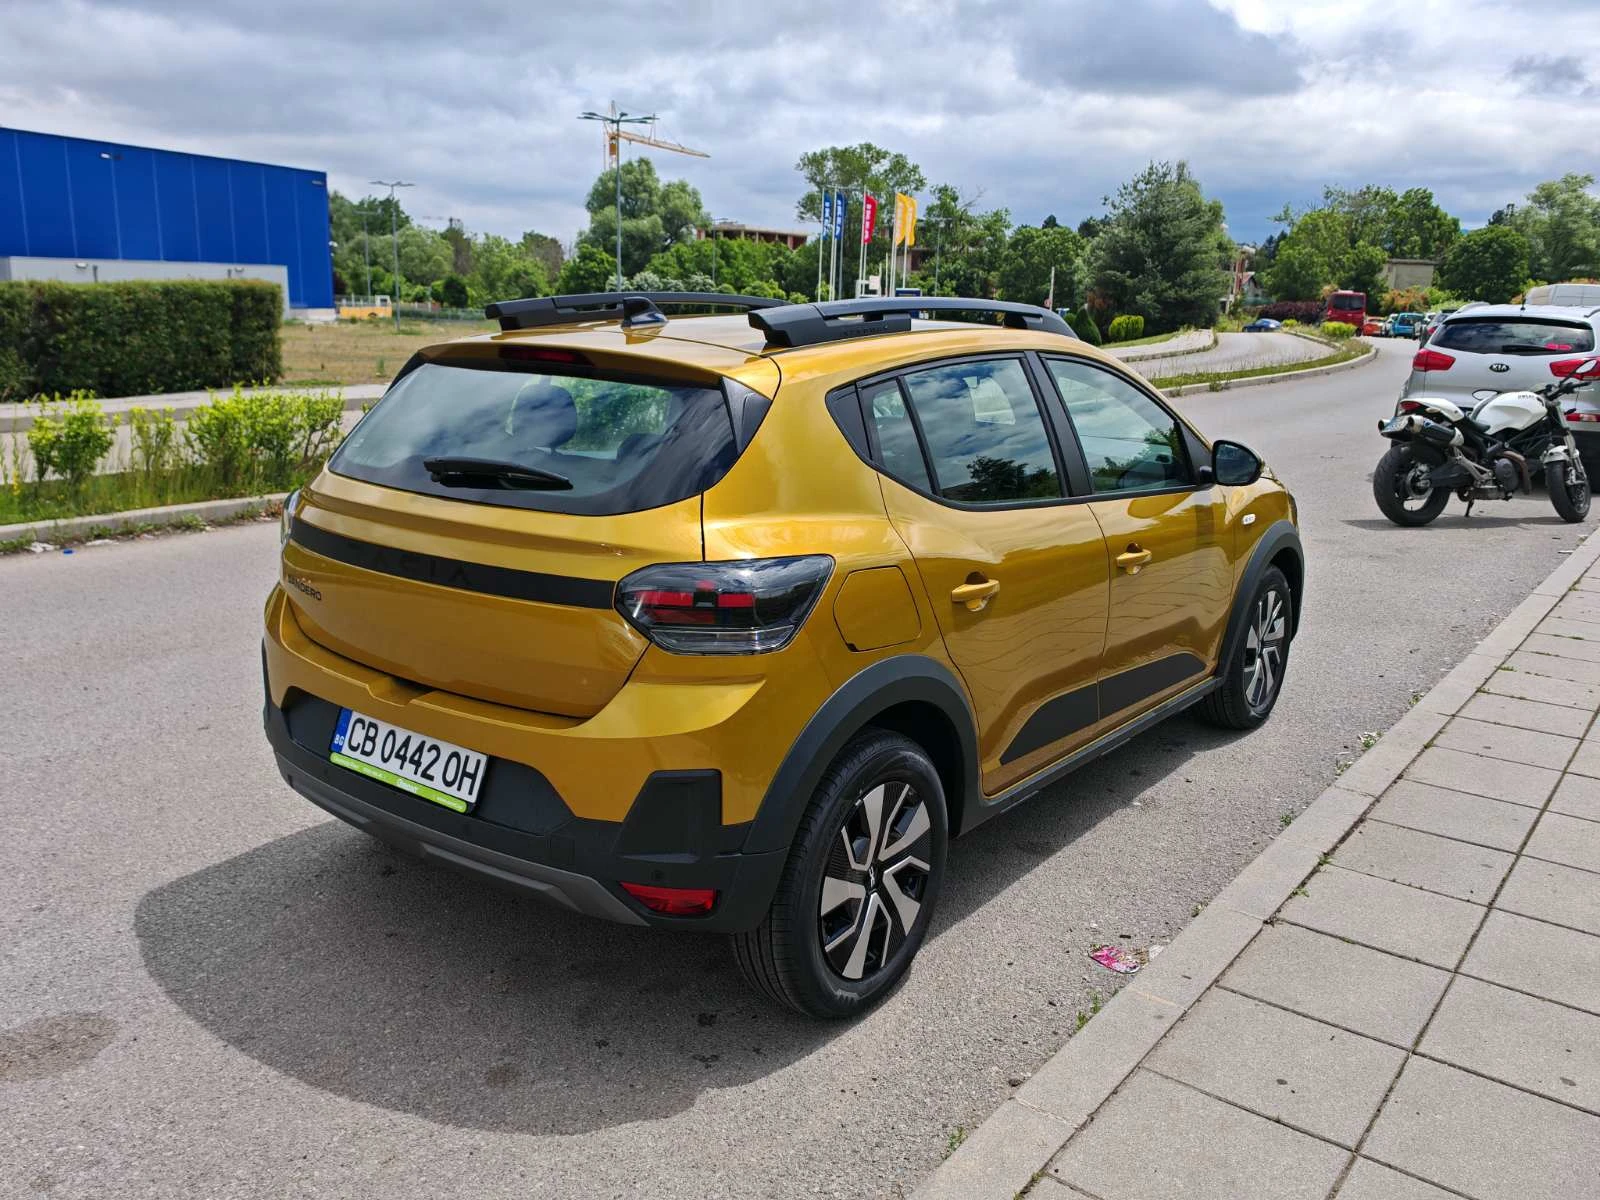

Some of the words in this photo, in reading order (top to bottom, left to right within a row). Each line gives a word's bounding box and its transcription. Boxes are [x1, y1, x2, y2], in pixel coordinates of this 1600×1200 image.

[334, 734, 345, 746] BG
[348, 717, 379, 757] CB
[381, 729, 441, 782] 0442
[442, 751, 481, 796] OH
